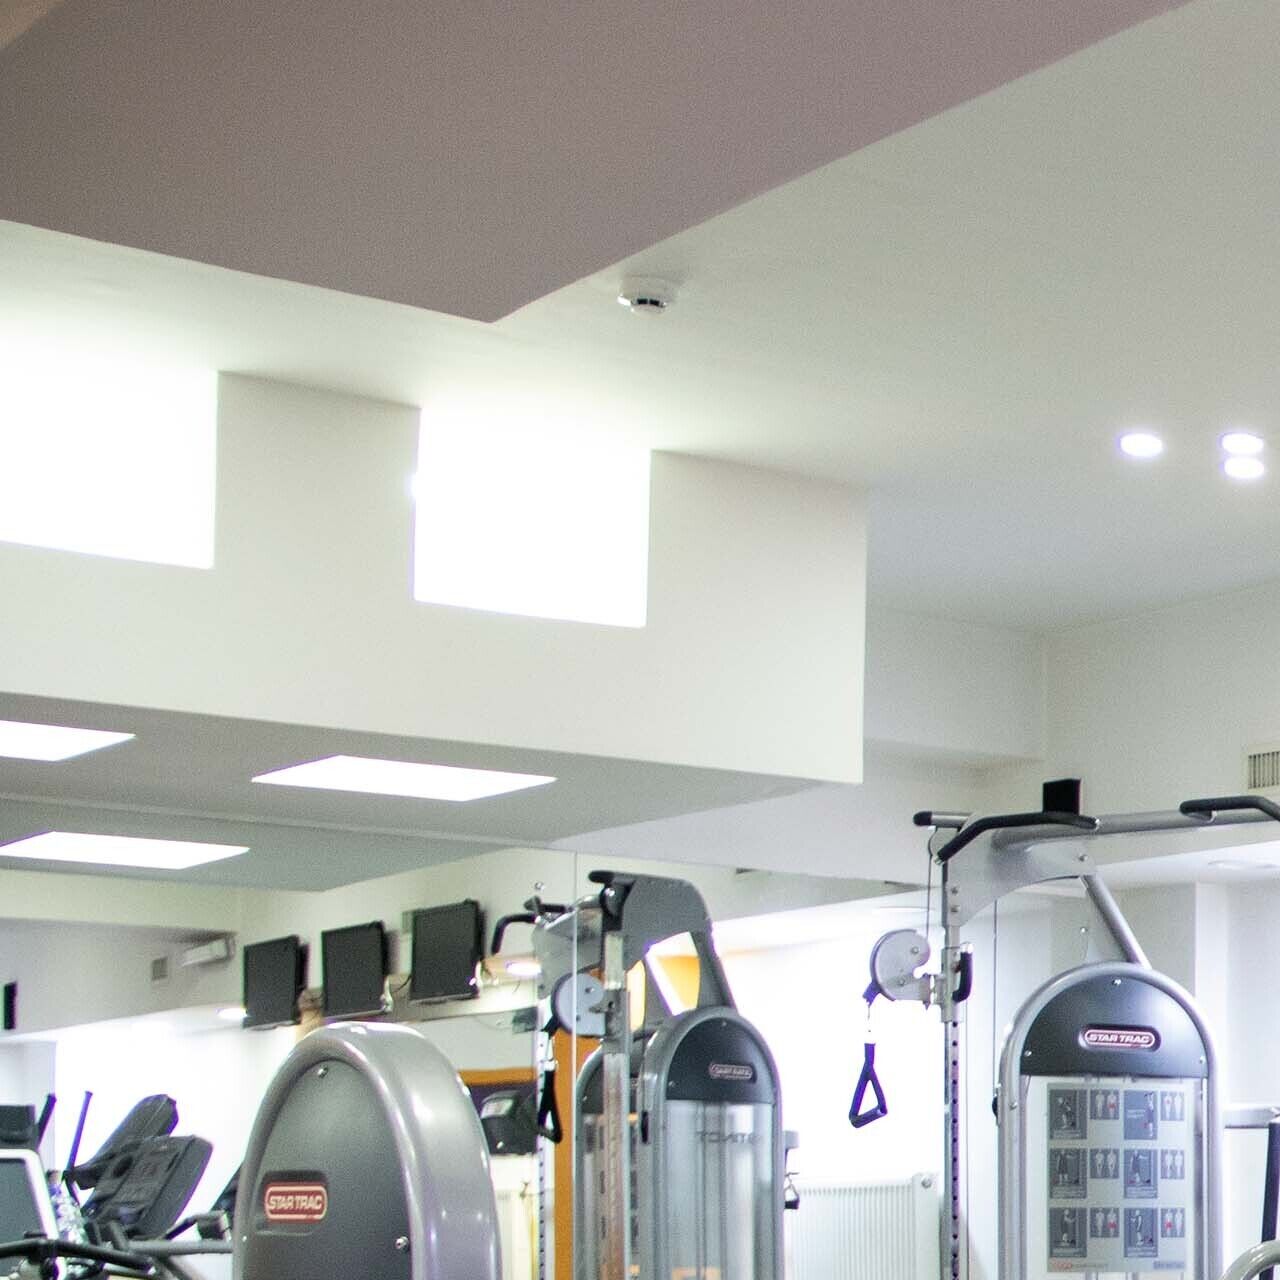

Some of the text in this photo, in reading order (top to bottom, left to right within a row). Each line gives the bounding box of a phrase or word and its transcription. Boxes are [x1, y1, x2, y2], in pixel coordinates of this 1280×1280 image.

[1087, 1033, 1150, 1044] STAR TRAC
[268, 1194, 322, 1211] STAR TRAC
